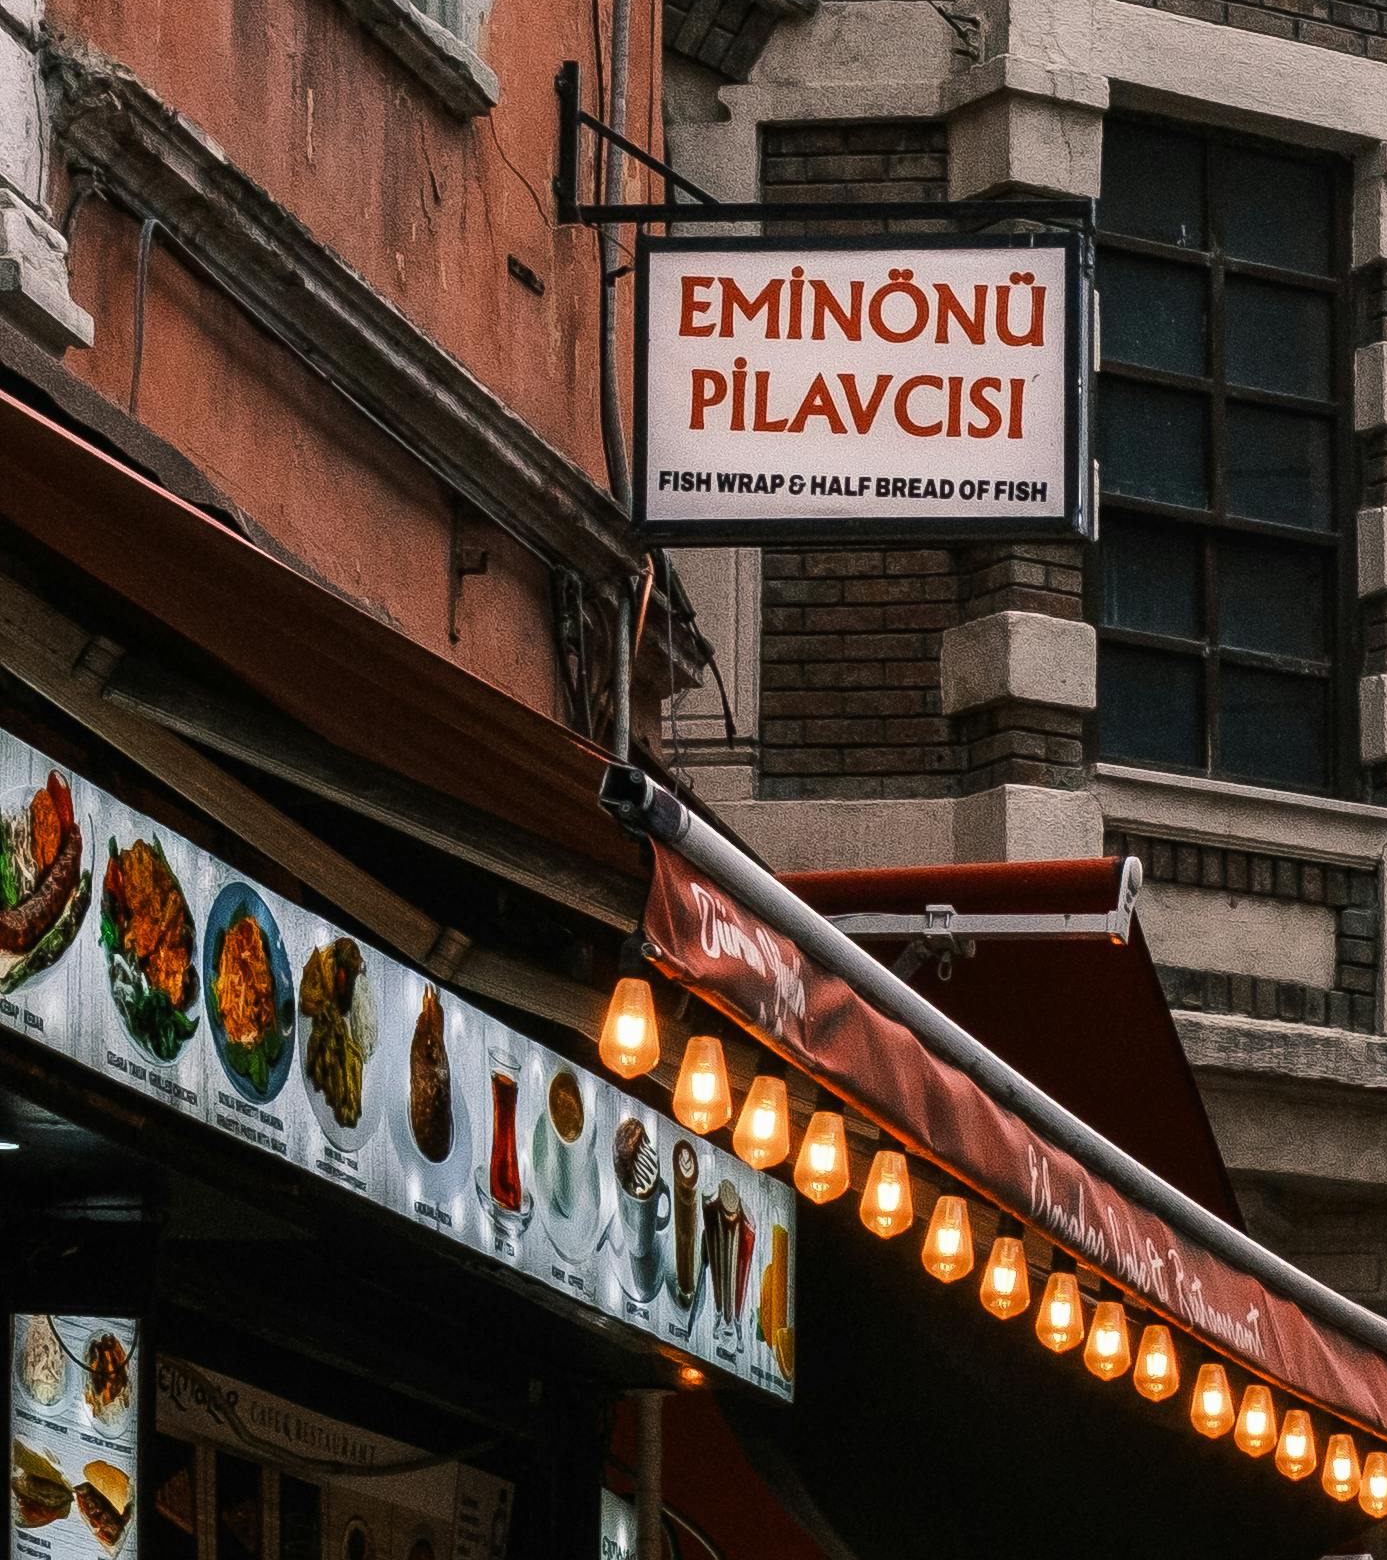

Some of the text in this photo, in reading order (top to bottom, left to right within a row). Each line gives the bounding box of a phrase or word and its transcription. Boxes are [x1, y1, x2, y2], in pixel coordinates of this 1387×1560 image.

[678, 265, 1047, 347] EMİNÖNÜ
[689, 356, 1026, 439] PİLAVCISI
[658, 470, 1048, 503] FISH WRAP & HALF BREAD OF FISH
